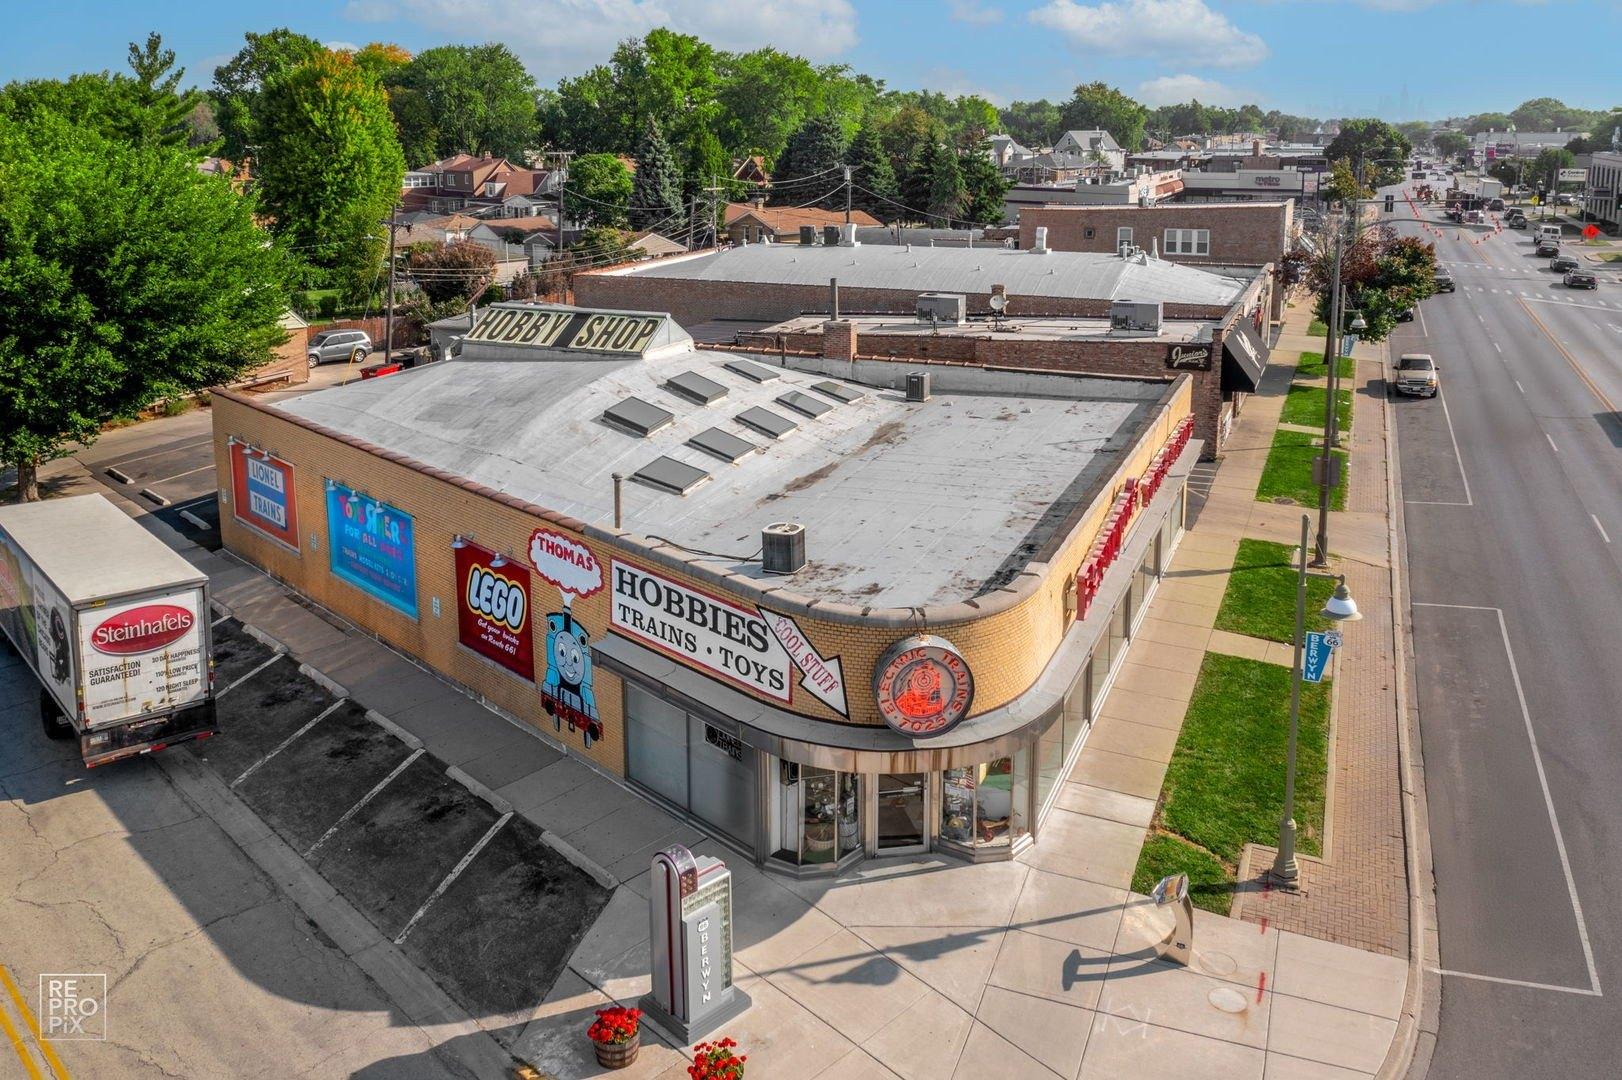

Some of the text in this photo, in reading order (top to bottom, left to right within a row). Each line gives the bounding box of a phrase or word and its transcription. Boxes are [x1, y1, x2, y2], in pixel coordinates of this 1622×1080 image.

[468, 309, 660, 350] HOBBY SHOP
[252, 461, 279, 488] LIONEL
[253, 494, 281, 520] TRAINS
[345, 524, 377, 548] FOR ALL
[537, 536, 594, 572] THOMAS
[468, 568, 525, 628] LEGO
[615, 565, 769, 653] HOBBIES
[96, 613, 191, 645] Steinhafels
[477, 618, 520, 646] Get your bricks
[488, 635, 505, 650] Route
[1326, 638, 1339, 646] 66
[170, 648, 201, 660] HAPPINESS
[618, 602, 785, 691] TRAINS TOYS
[774, 616, 839, 694] COOL STUFF
[1307, 634, 1320, 680] BERWYN
[89, 660, 141, 679] SATISFACTION
[90, 668, 141, 686] GUARANTEED!
[880, 647, 970, 715] ELECTRIC TRAINS
[166, 681, 182, 690] NIGHT
[182, 678, 199, 687] SLEEP
[899, 716, 947, 732] 7025
[701, 932, 711, 1004] BERWYN
